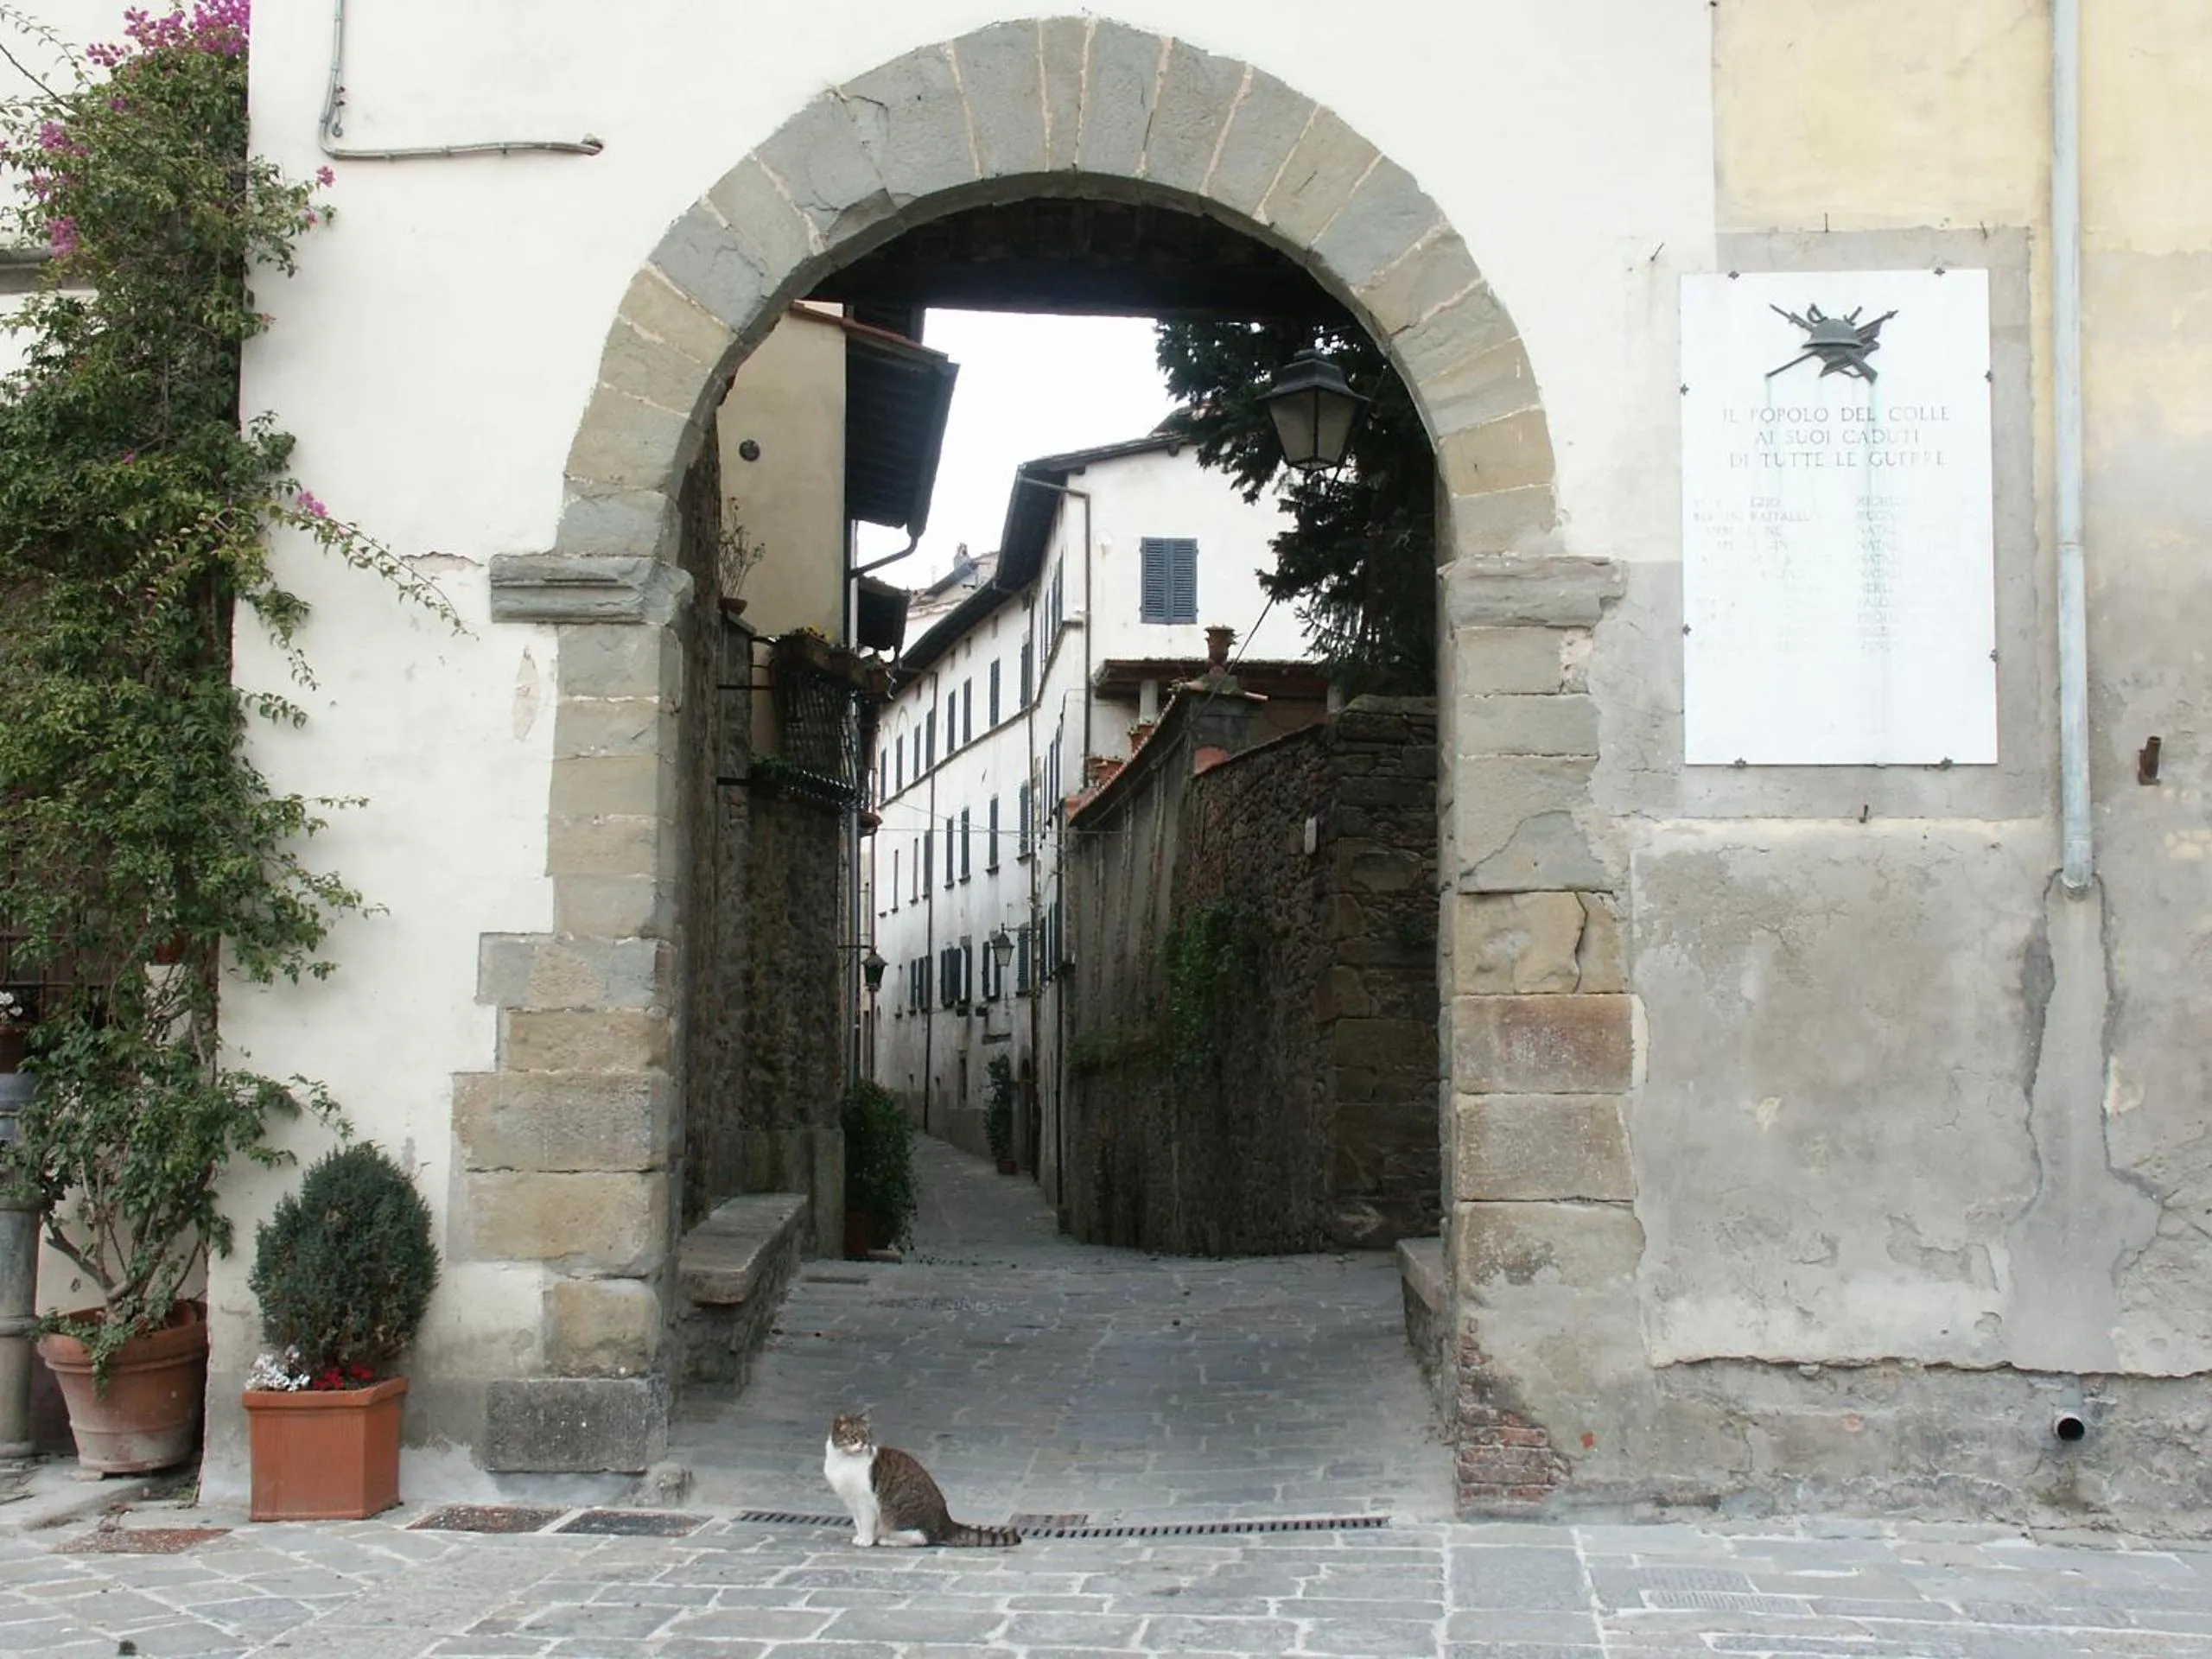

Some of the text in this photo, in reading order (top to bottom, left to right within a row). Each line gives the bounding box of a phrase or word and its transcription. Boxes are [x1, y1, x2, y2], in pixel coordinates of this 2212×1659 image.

[1840, 406, 1876, 423] DEL
[1888, 405, 1950, 423] COLLE
[1755, 429, 1920, 445] AI SUOI CADUTI
[1729, 452, 1749, 468] DI
[1759, 451, 1825, 468] TUTTE
[1835, 451, 1857, 467] LE
